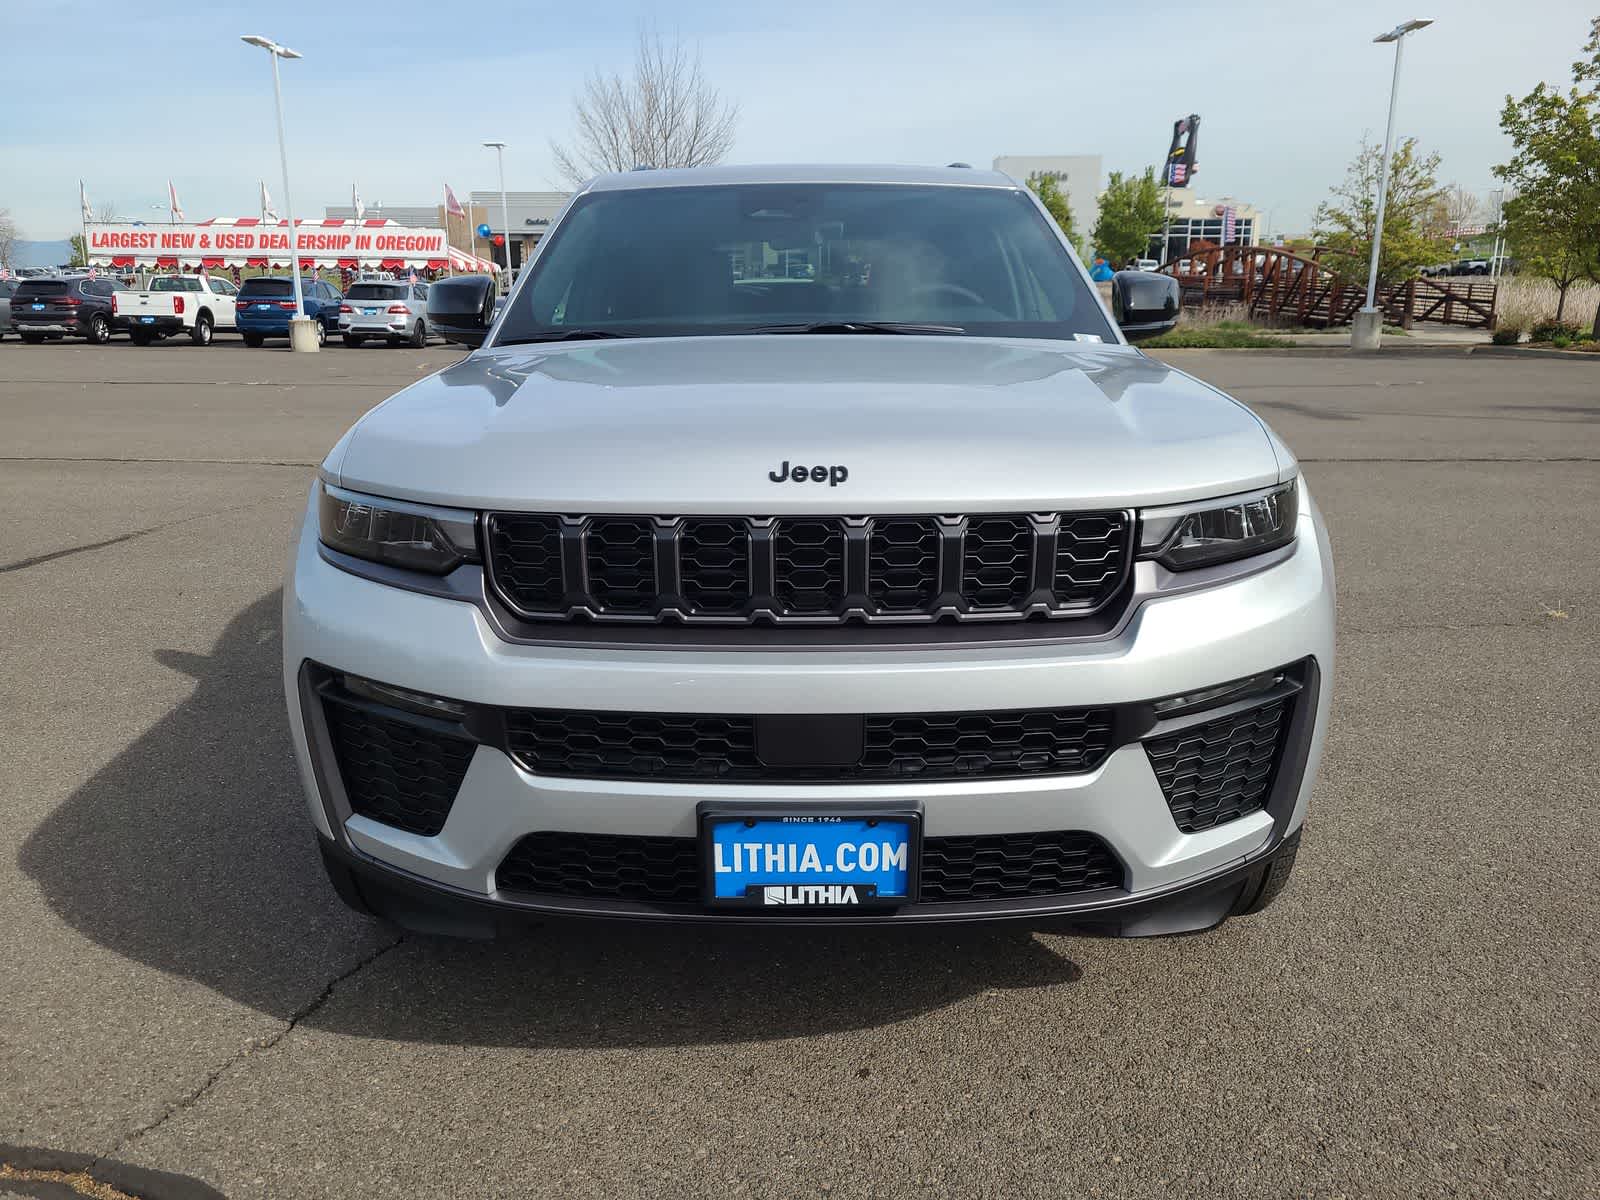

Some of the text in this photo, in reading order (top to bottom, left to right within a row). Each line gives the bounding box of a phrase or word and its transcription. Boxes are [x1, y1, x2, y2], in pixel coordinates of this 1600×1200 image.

[92, 232, 442, 251] LARGEST NEW & USED DEAERSHIP IN OREGON!
[769, 460, 848, 487] Jeep
[714, 842, 907, 873] LITHIA.COM
[785, 885, 859, 904] LITHIA
